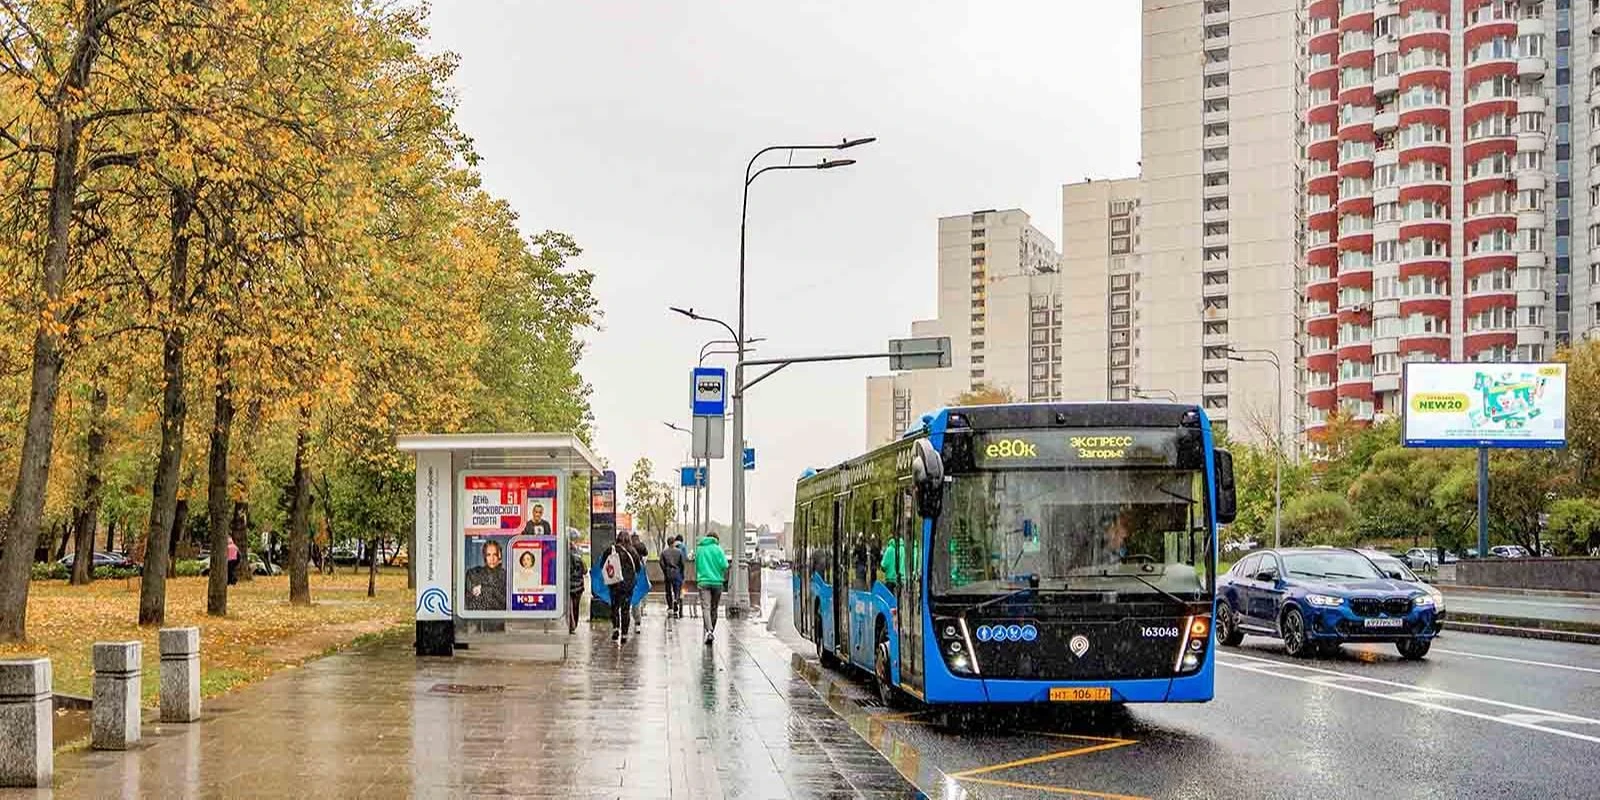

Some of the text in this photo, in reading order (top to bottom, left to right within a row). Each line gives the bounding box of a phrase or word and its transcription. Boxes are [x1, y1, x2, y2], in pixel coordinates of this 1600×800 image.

[1420, 400, 1463, 410] NEW20
[1070, 436, 1133, 448] ЭКСПРЕСС
[986, 439, 1036, 457] е80к
[1079, 448, 1125, 459] Загорье
[472, 495, 489, 505] ДЕНЬ
[472, 505, 519, 515] МОСКОВСКОГО
[472, 516, 497, 526] СПОРТА
[1141, 627, 1179, 637] 163048
[1073, 689, 1092, 699] 106
